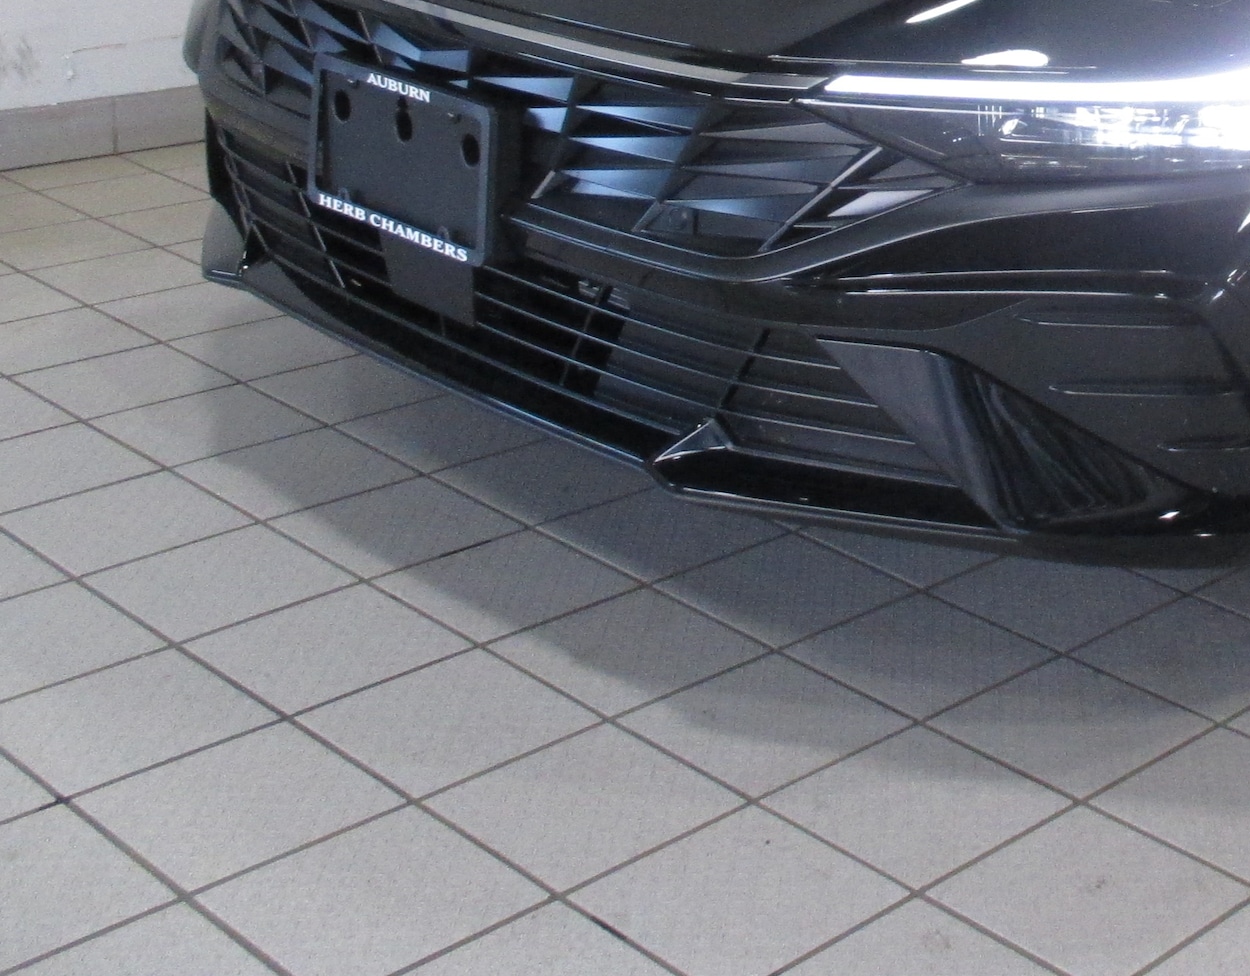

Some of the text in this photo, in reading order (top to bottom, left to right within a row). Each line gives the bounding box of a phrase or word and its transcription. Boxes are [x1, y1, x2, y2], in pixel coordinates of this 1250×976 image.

[366, 73, 431, 103] AUBURN
[318, 193, 468, 262] HERB CHAMBERS
